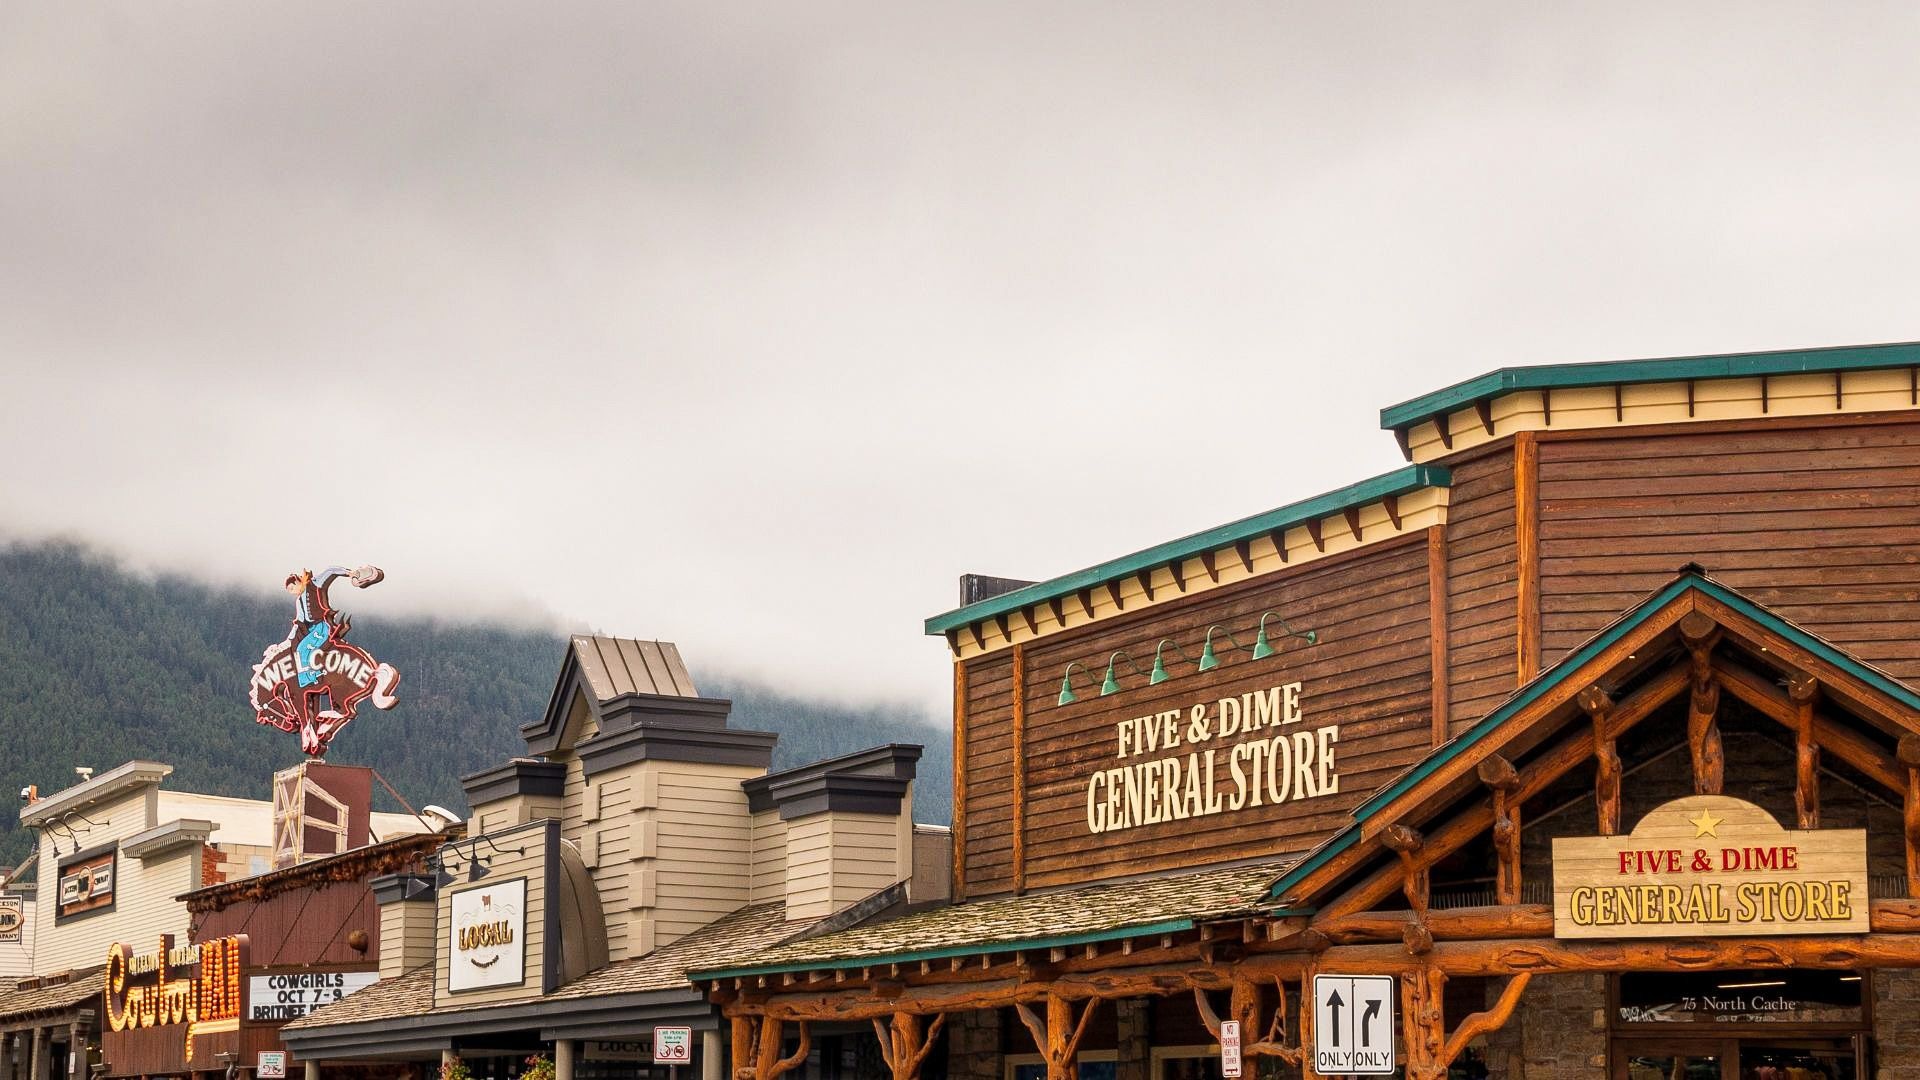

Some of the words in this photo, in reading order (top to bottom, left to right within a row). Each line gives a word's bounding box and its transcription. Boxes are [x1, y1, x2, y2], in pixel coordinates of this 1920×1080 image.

[257, 649, 373, 692] WELCOME
[1117, 709, 1181, 759] FIVE
[1187, 703, 1213, 744] &
[1218, 682, 1302, 738] DIME
[1087, 749, 1222, 834] GENERAL
[1229, 725, 1339, 811] STORE
[1618, 849, 1684, 874] FIVE
[1691, 848, 1713, 872] &
[1720, 846, 1798, 871] DIME
[1570, 883, 1729, 926] GENERAL
[1736, 880, 1851, 922] STORE
[459, 920, 513, 951] LOCAL
[200, 934, 240, 1021] BAR
[268, 973, 344, 990] COWGIRLS
[277, 989, 305, 1004] OCT
[1681, 996, 1697, 1011] 75
[1703, 996, 1746, 1011] North
[1751, 996, 1796, 1011] Cache
[253, 1003, 307, 1019] BRITNEE
[1226, 1025, 1234, 1035] NO
[1222, 1036, 1240, 1048] PARKING
[1319, 1052, 1352, 1067] ONLY
[1355, 1052, 1390, 1067] ONLY
